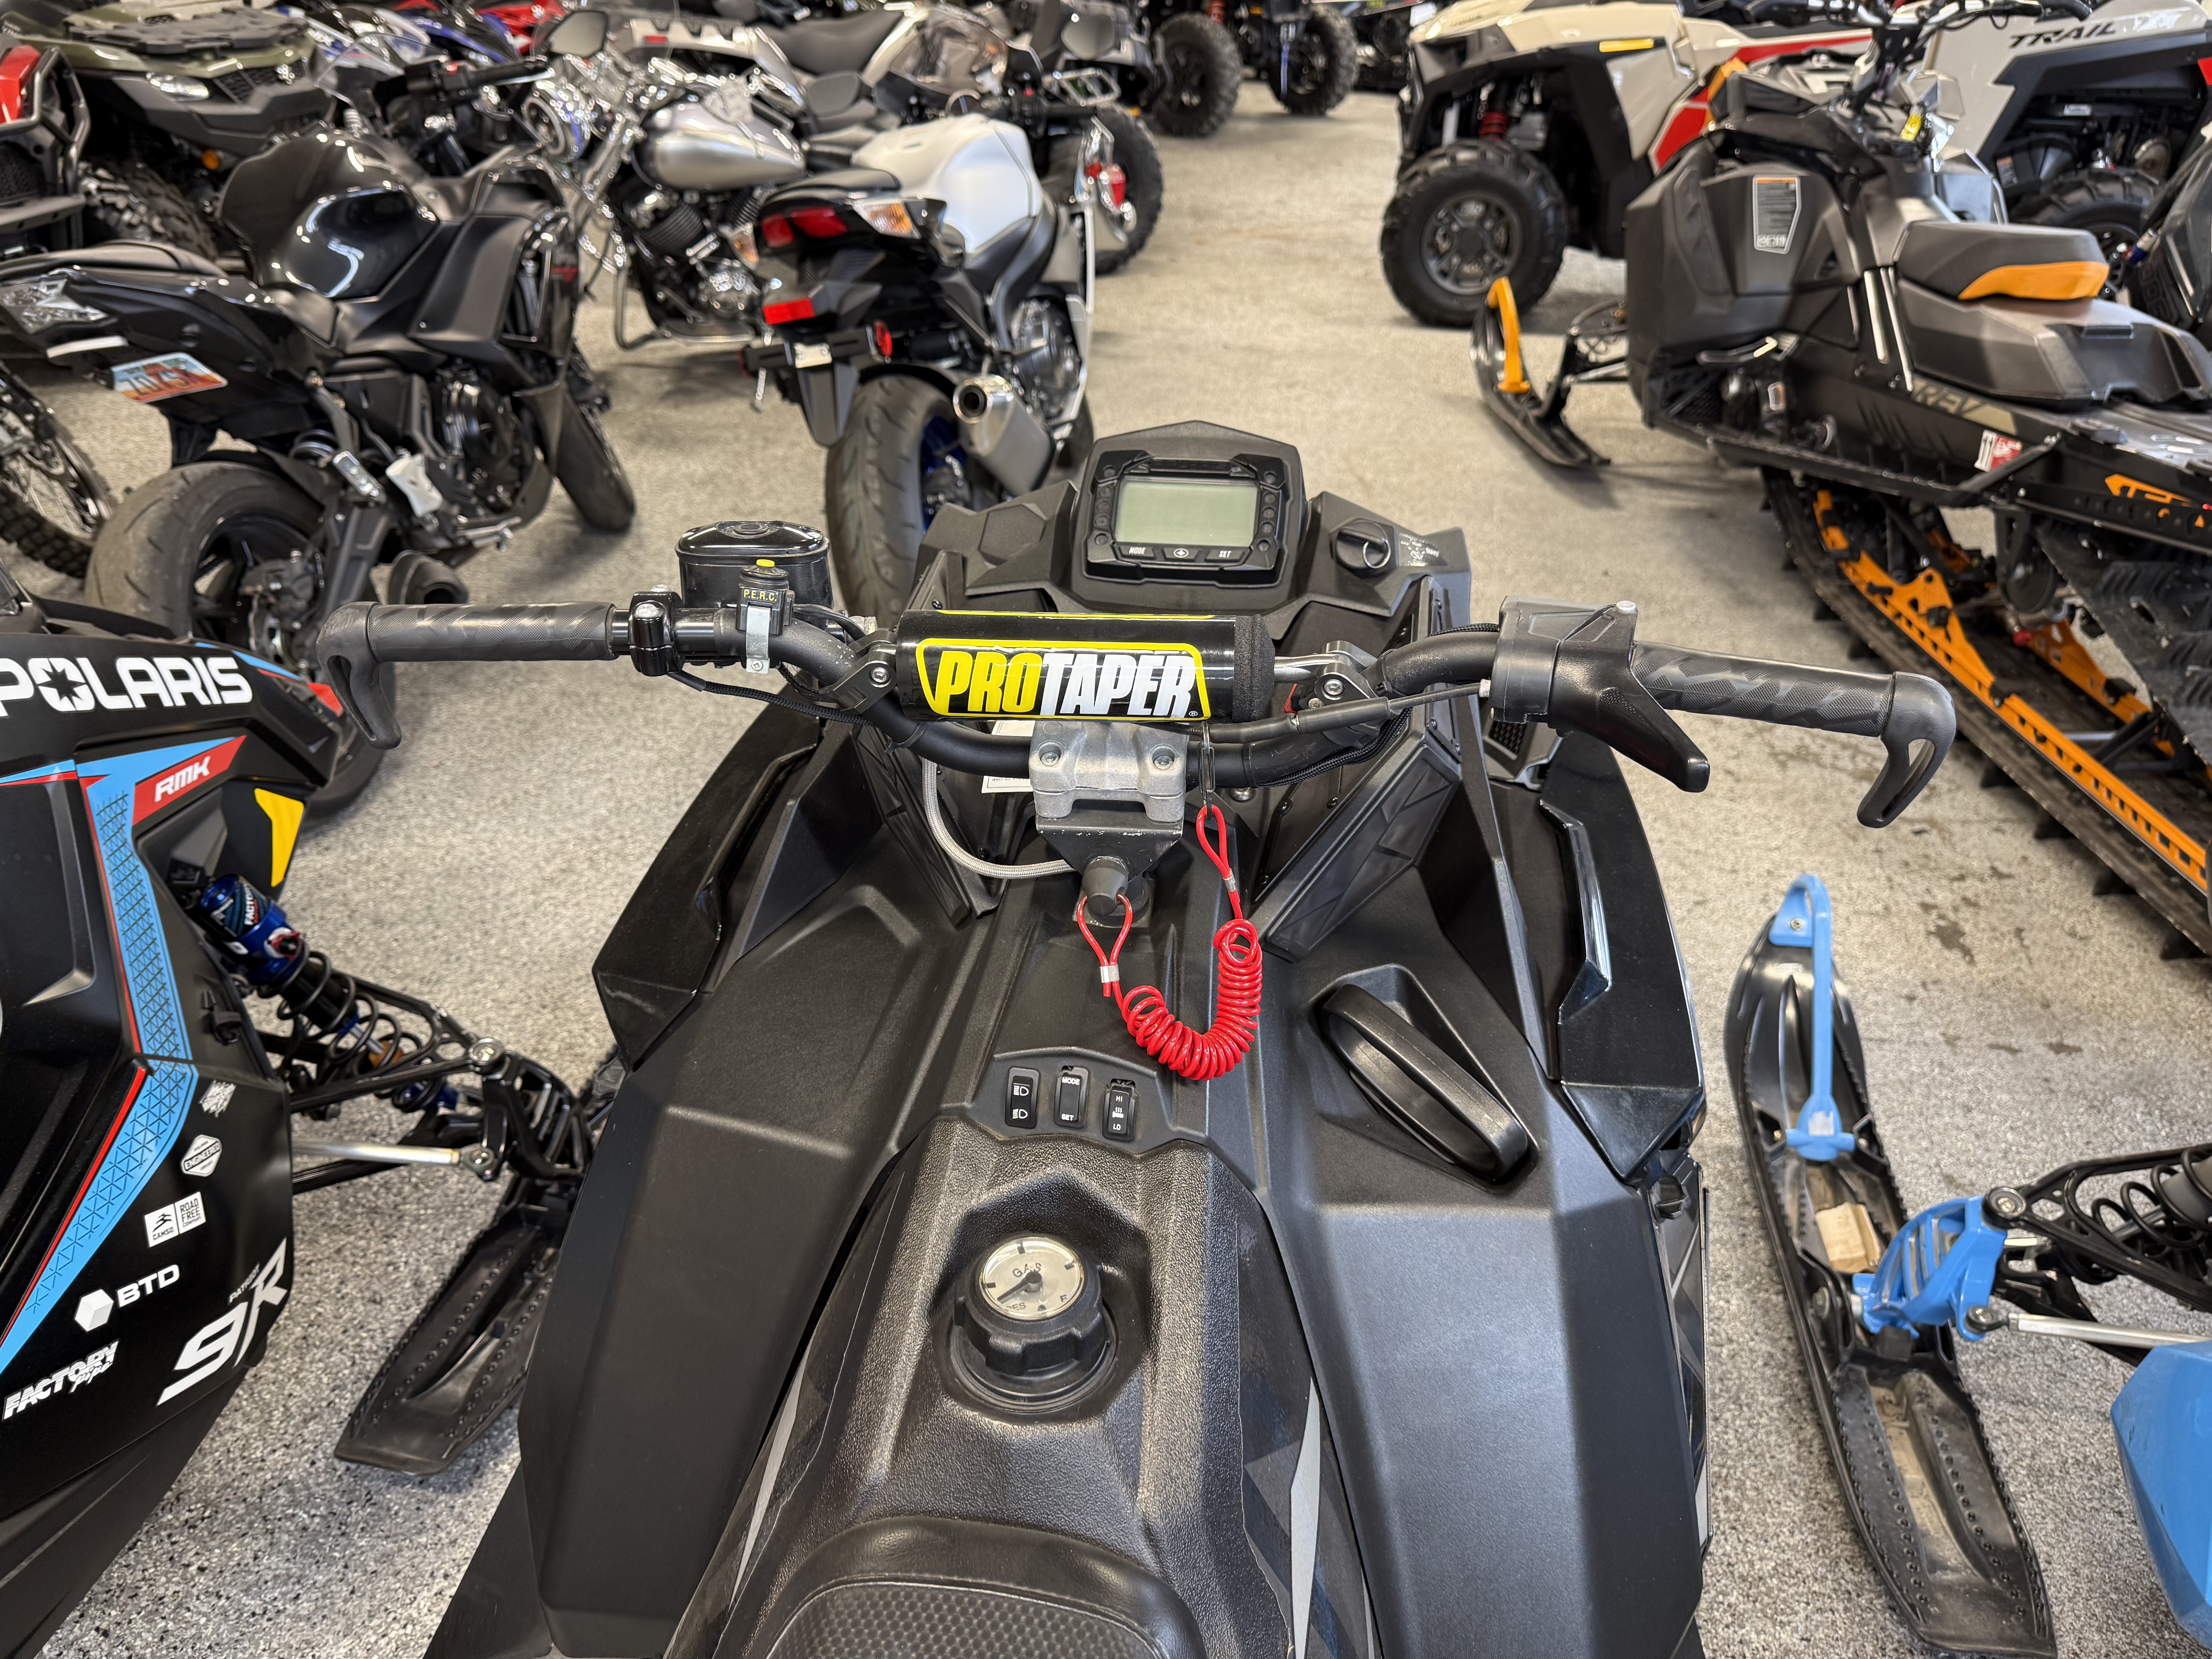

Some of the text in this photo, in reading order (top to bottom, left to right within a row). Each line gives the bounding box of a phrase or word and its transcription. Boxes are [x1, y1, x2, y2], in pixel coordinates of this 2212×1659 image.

[2009, 21, 2117, 49] TRAIL
[1128, 546, 1146, 555] MODE
[744, 589, 777, 602] P.E.R.C.
[0, 658, 252, 718] POLARIS
[155, 756, 211, 802] RMK
[1062, 1077, 1080, 1085] MODE
[180, 1198, 199, 1213] ROAD
[181, 1207, 201, 1223] FREE
[153, 1227, 174, 1240] CAMSO
[117, 1264, 180, 1308] BTD
[3, 1340, 118, 1420] FACTORY
